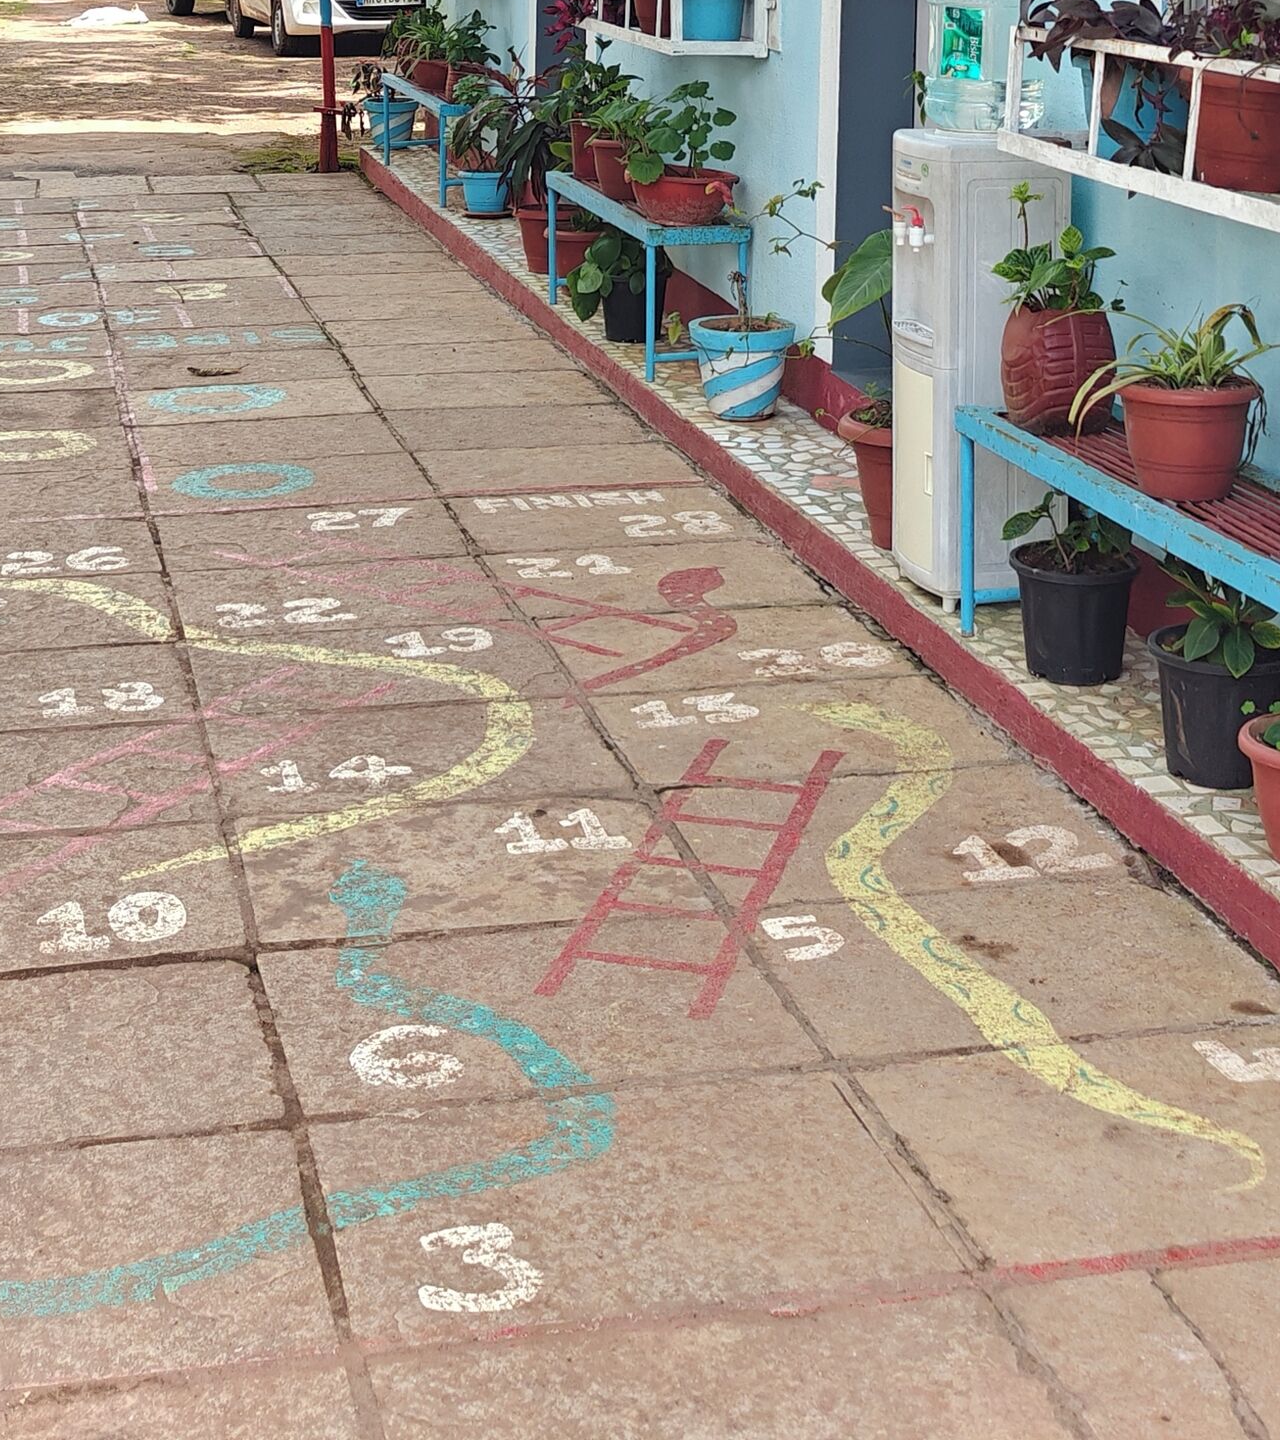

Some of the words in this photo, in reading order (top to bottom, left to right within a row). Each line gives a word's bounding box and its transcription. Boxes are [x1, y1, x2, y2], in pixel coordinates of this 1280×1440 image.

[307, 507, 414, 533] 27
[473, 490, 666, 513] FINISH
[617, 511, 733, 538] 28
[1, 545, 130, 576] 26
[506, 554, 633, 579] 21
[215, 597, 357, 628] 22
[385, 627, 493, 658] 19
[38, 681, 166, 718] 18
[630, 692, 759, 729] 13
[260, 755, 413, 793] 14
[494, 808, 632, 855] 11
[953, 824, 1114, 883] 12
[37, 891, 188, 955] 10
[761, 914, 846, 962] 5
[348, 1024, 466, 1088] 6
[417, 1222, 544, 1312] 3
